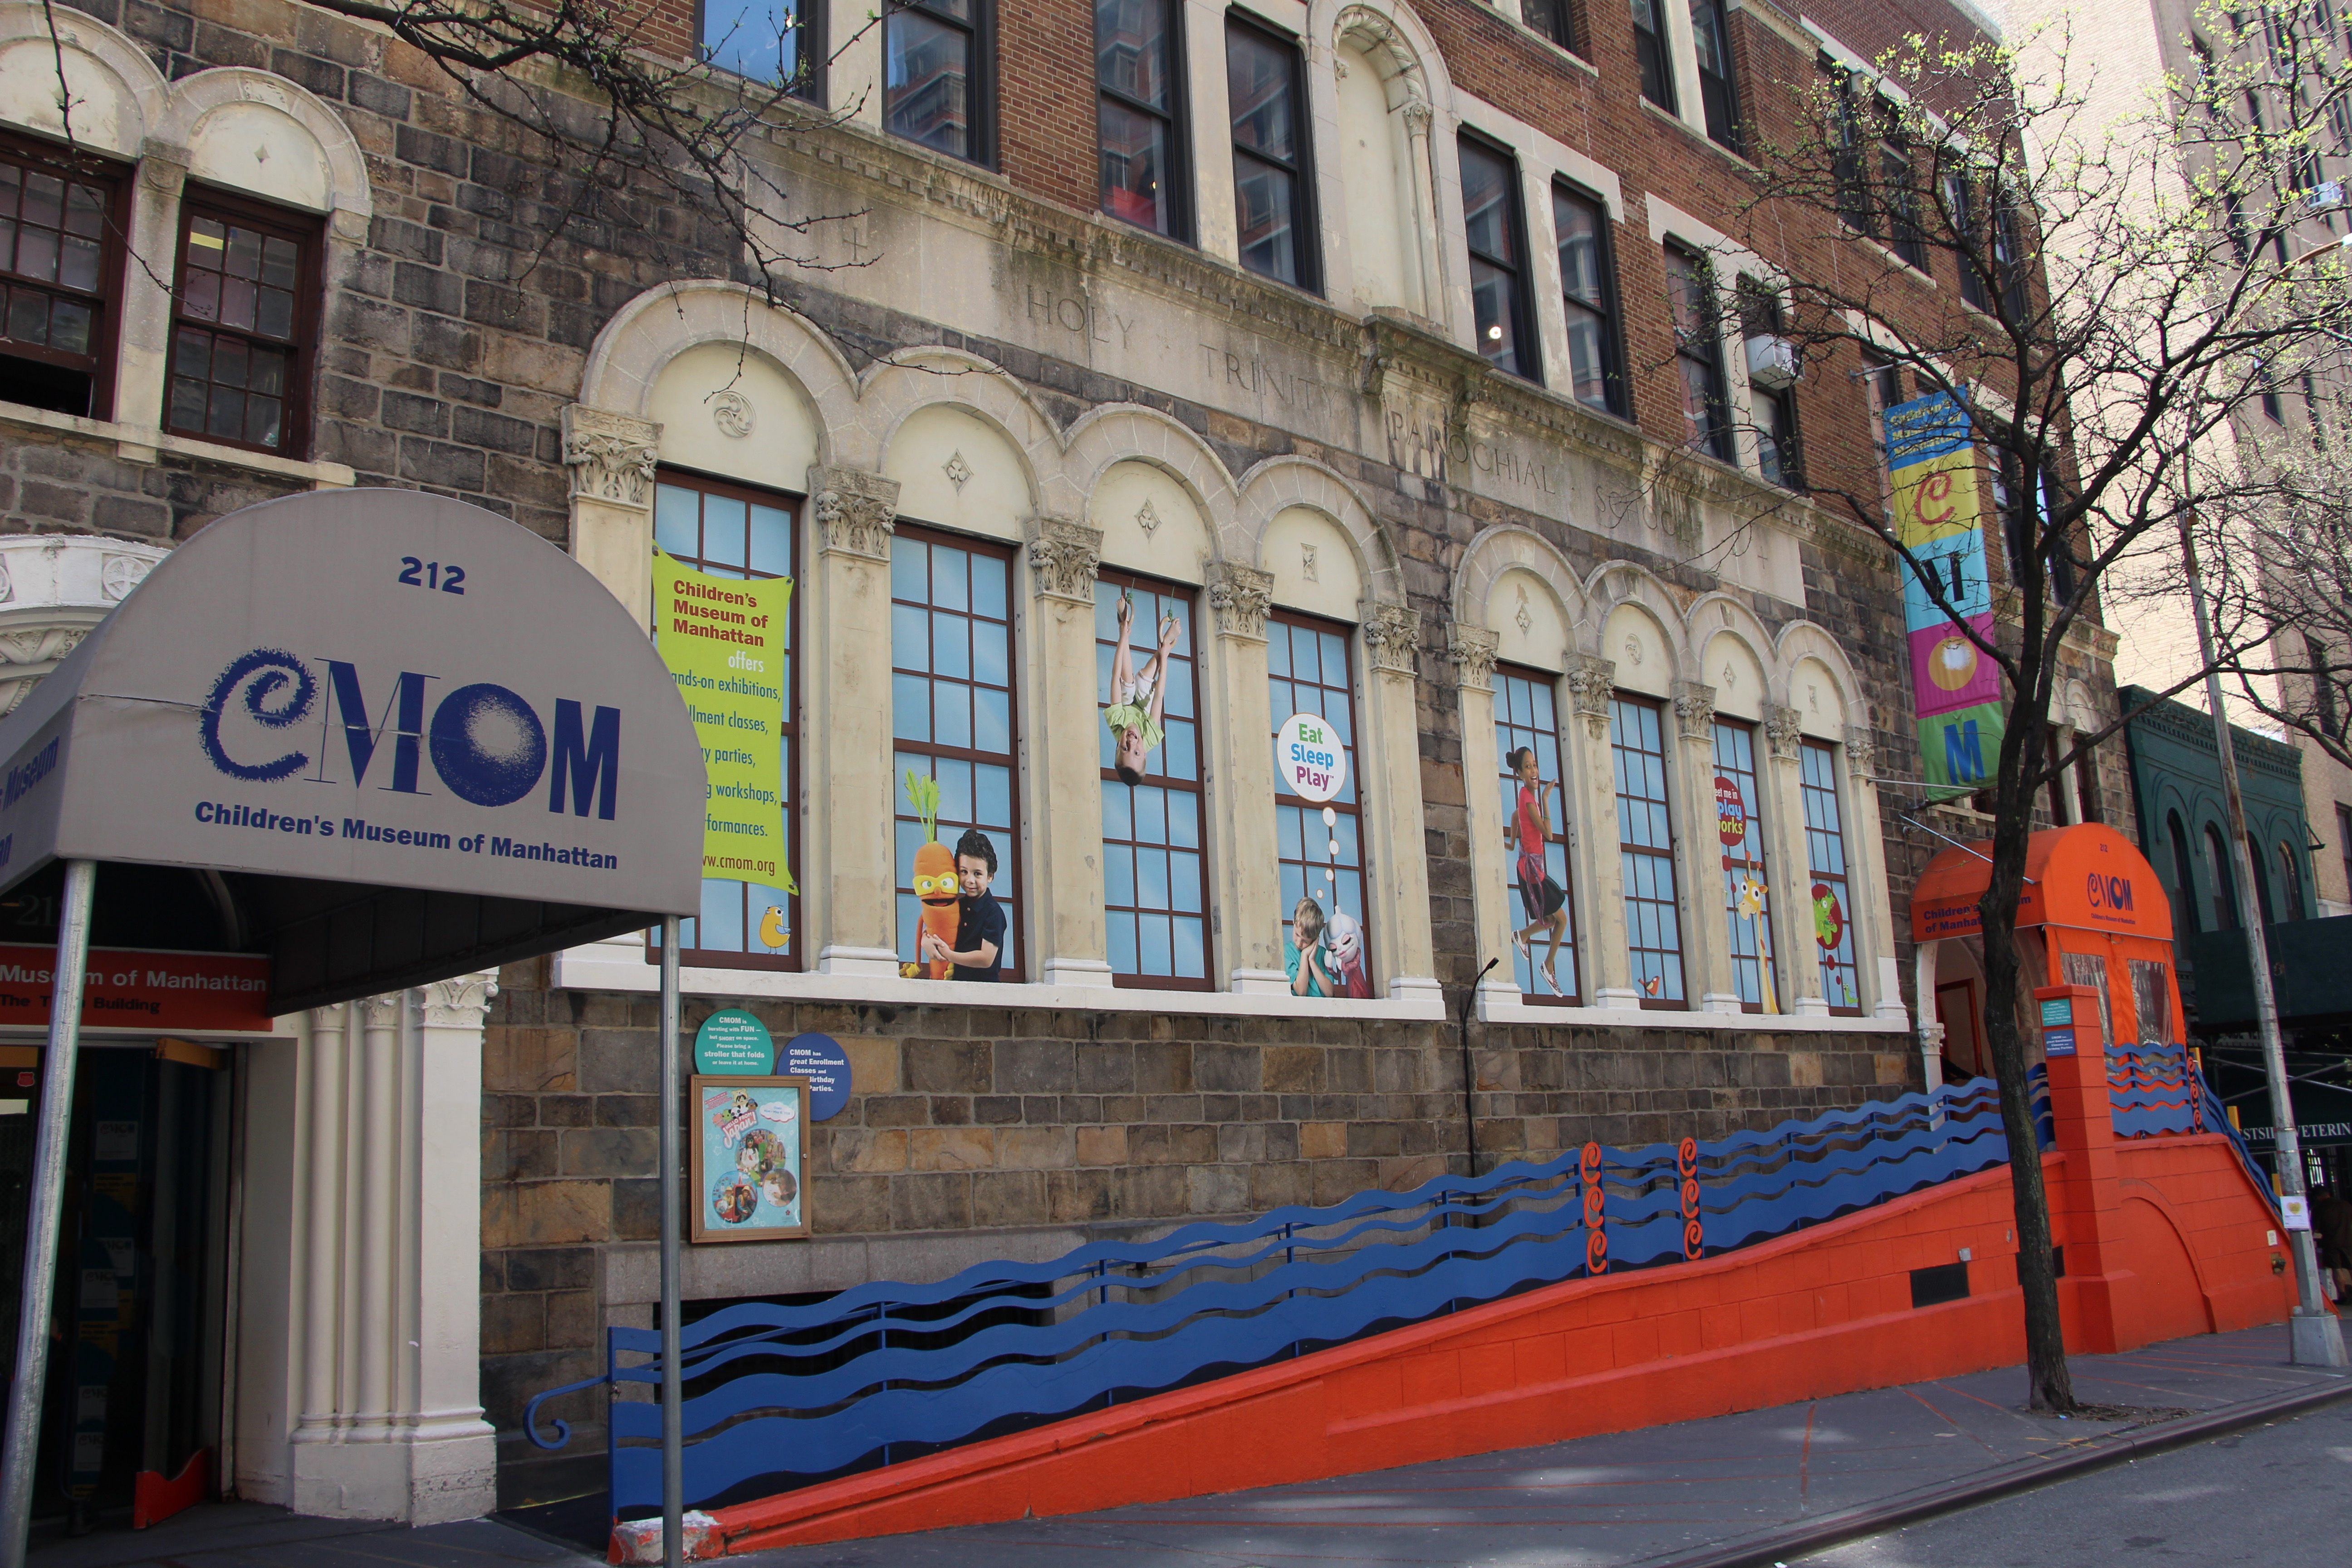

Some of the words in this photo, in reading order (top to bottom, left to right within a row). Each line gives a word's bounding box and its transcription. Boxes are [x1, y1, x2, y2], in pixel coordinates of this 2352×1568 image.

[1027, 284, 1133, 349] HOLY
[1200, 343, 1338, 418] TRINITY
[1391, 410, 1556, 494] PAROCHIAL
[398, 556, 466, 595] 212
[674, 580, 757, 608] Children's
[673, 599, 745, 625] Museum
[751, 615, 769, 628] of
[673, 618, 764, 647] Manhattan
[728, 650, 764, 672] offers
[671, 669, 714, 690] ands-on
[719, 676, 781, 703] exhibitions,
[689, 704, 725, 726] llment
[728, 711, 768, 735] classes,
[198, 646, 621, 821] CMOM
[1299, 723, 1323, 745] Eat
[715, 749, 755, 769] parties,
[1291, 743, 1333, 771] Sleep
[716, 781, 777, 806] workshops,
[1724, 790, 1732, 799] me
[1732, 789, 1738, 799] in
[1717, 799, 1743, 821] play
[195, 801, 334, 837] Children's
[342, 818, 451, 850] Museum
[458, 833, 485, 854] of
[490, 837, 617, 870] Manhattan
[2100, 843, 2108, 853] 212
[16, 894, 59, 926] 21
[1926, 923, 1937, 933] of
[1940, 916, 1982, 931] Manhat
[0, 965, 103, 985] Musm
[113, 970, 138, 986] of
[147, 970, 267, 992] Manhattan
[93, 997, 162, 1015] Building
[725, 1118, 739, 1129] HELLO
[739, 1112, 752, 1122] FROM
